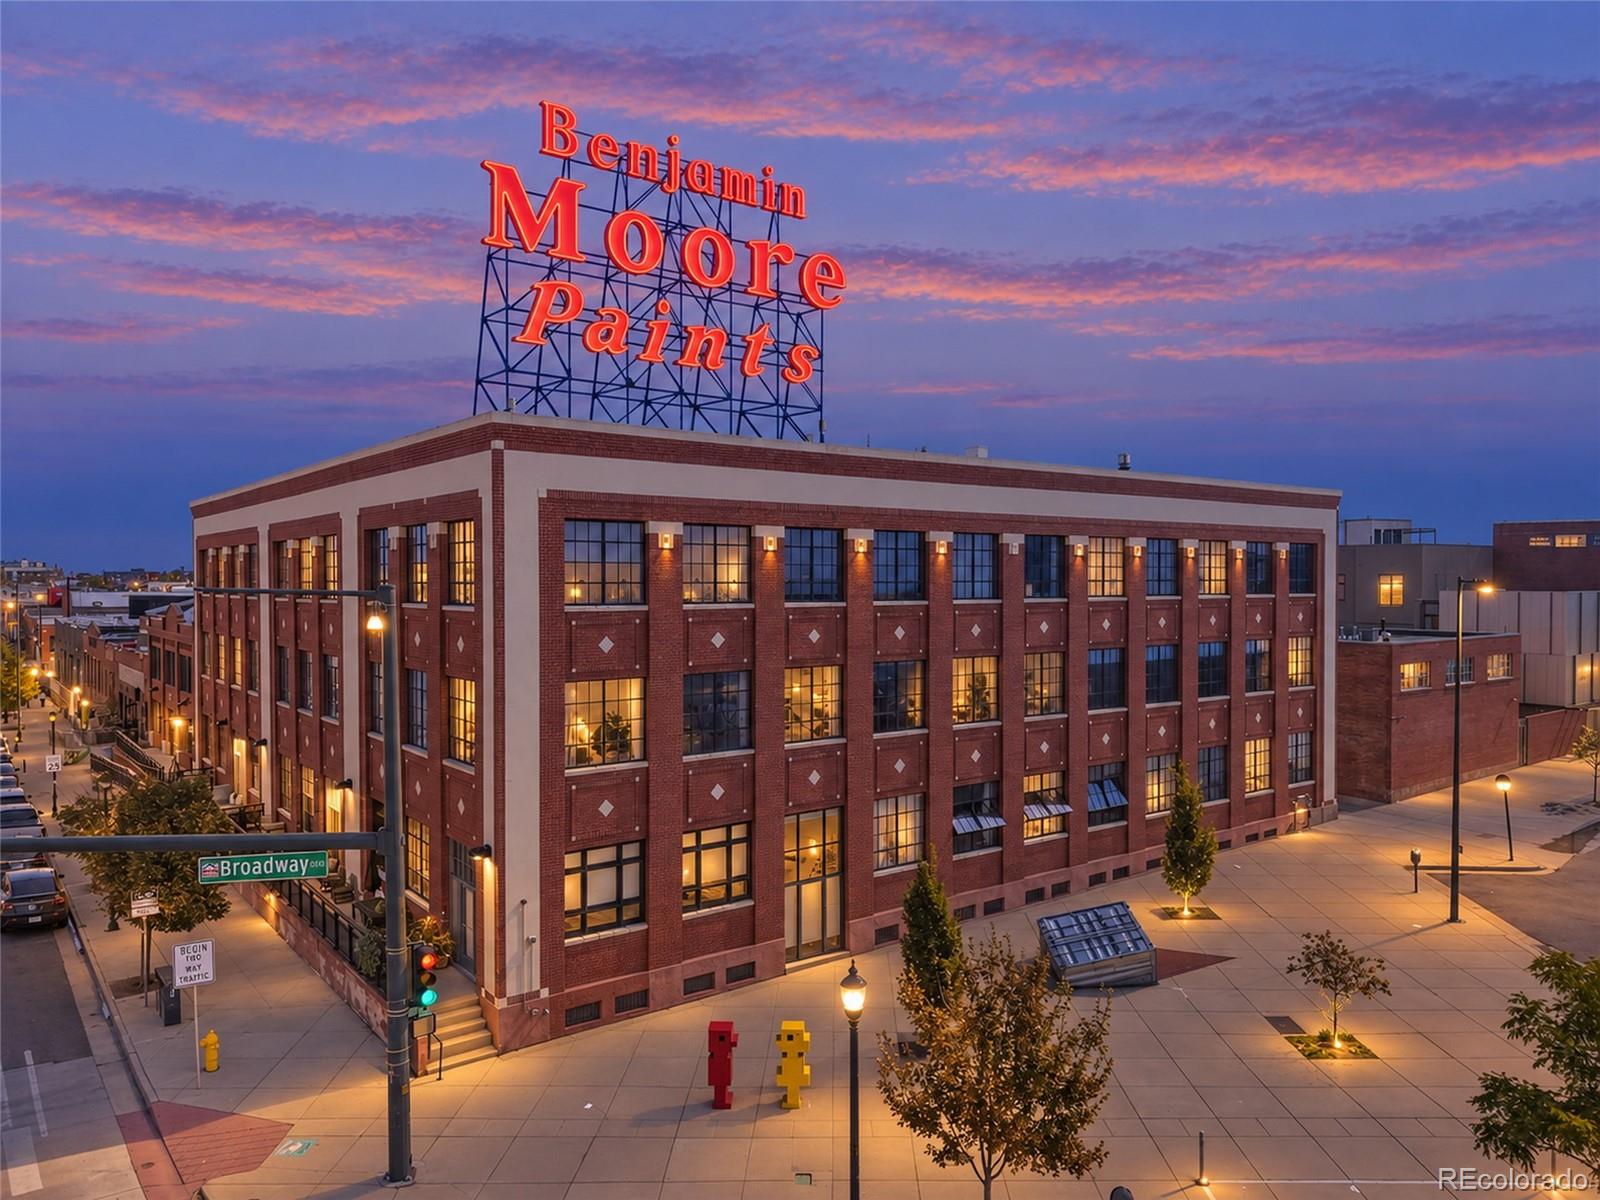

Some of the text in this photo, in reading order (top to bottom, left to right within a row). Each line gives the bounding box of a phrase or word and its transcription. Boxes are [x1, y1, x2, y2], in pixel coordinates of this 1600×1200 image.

[538, 99, 807, 219] Benjamin
[480, 159, 848, 310] Moore
[512, 279, 821, 384] Paints
[220, 856, 309, 876] Broadway
